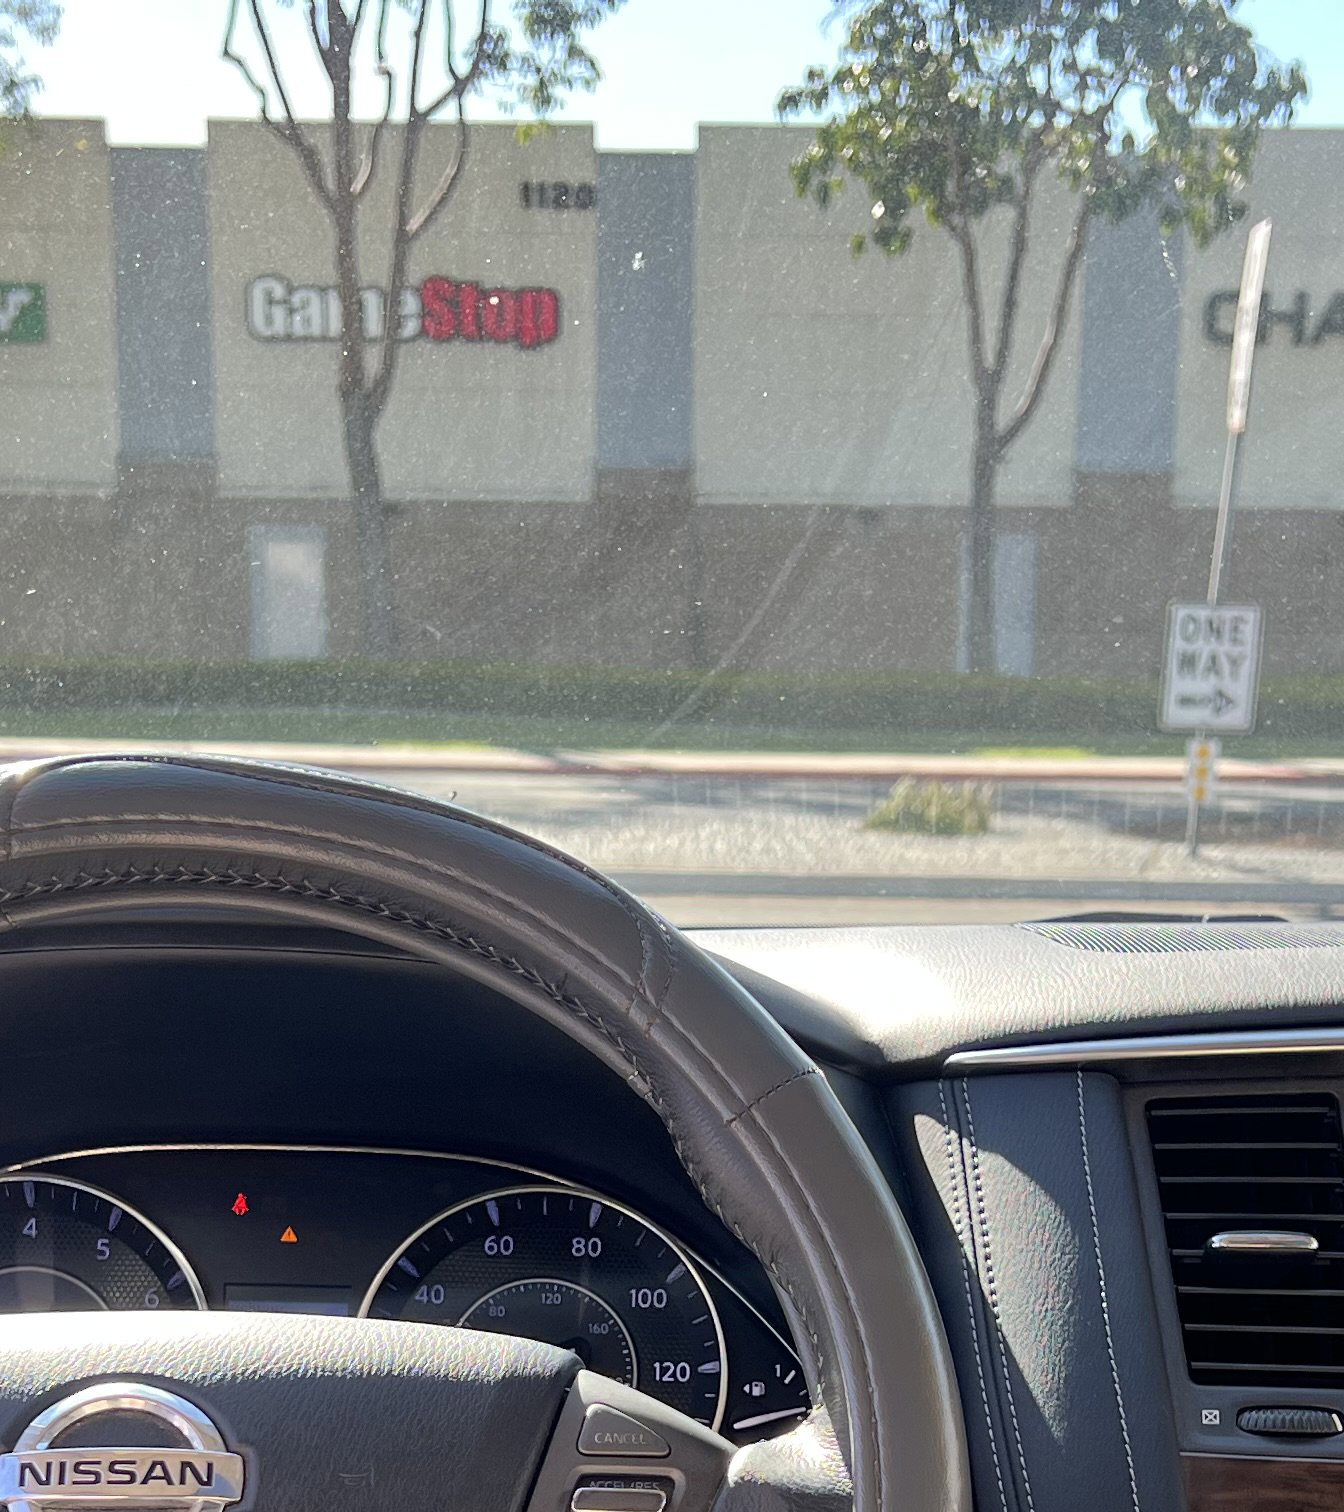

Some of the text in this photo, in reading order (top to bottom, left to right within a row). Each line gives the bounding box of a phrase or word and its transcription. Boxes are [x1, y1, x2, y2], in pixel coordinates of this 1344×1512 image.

[251, 275, 560, 349] GameStop
[1180, 613, 1248, 646] ONE
[1176, 649, 1248, 681] WAY
[22, 1217, 39, 1239] 4
[96, 1238, 111, 1260] 5
[483, 1236, 514, 1256] 60
[571, 1237, 602, 1258] 80
[144, 1287, 160, 1308] 6
[415, 1285, 445, 1305] 40
[541, 1293, 562, 1305] 120
[630, 1288, 667, 1309] 100
[489, 1306, 506, 1318] 80
[588, 1323, 609, 1335] 160
[653, 1361, 691, 1383] 120
[594, 1431, 646, 1446] CANCEL
[18, 1459, 215, 1488] NISSAN
